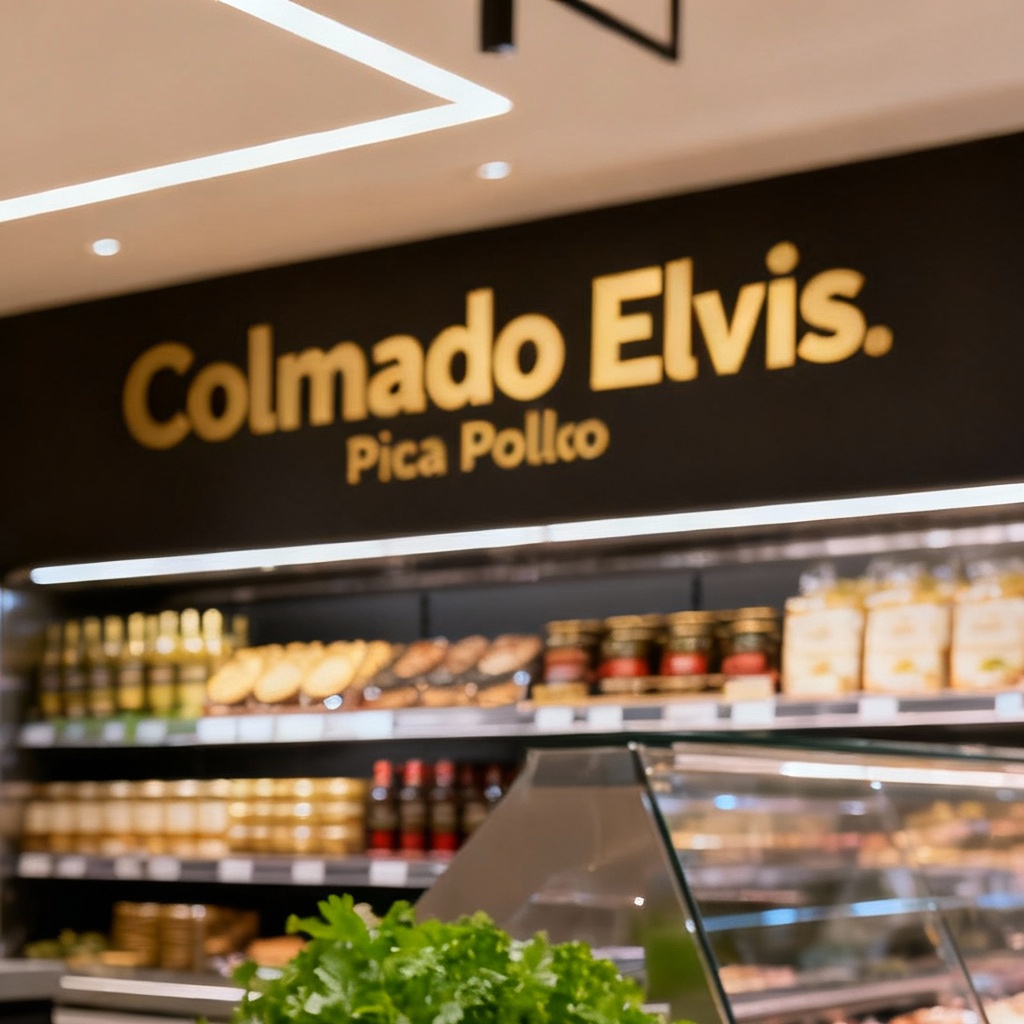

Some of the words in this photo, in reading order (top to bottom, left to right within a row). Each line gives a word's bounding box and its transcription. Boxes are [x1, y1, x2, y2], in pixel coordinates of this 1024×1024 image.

[124, 288, 565, 449] Colmado
[590, 242, 893, 391] Elvis.
[346, 430, 448, 485] Pica
